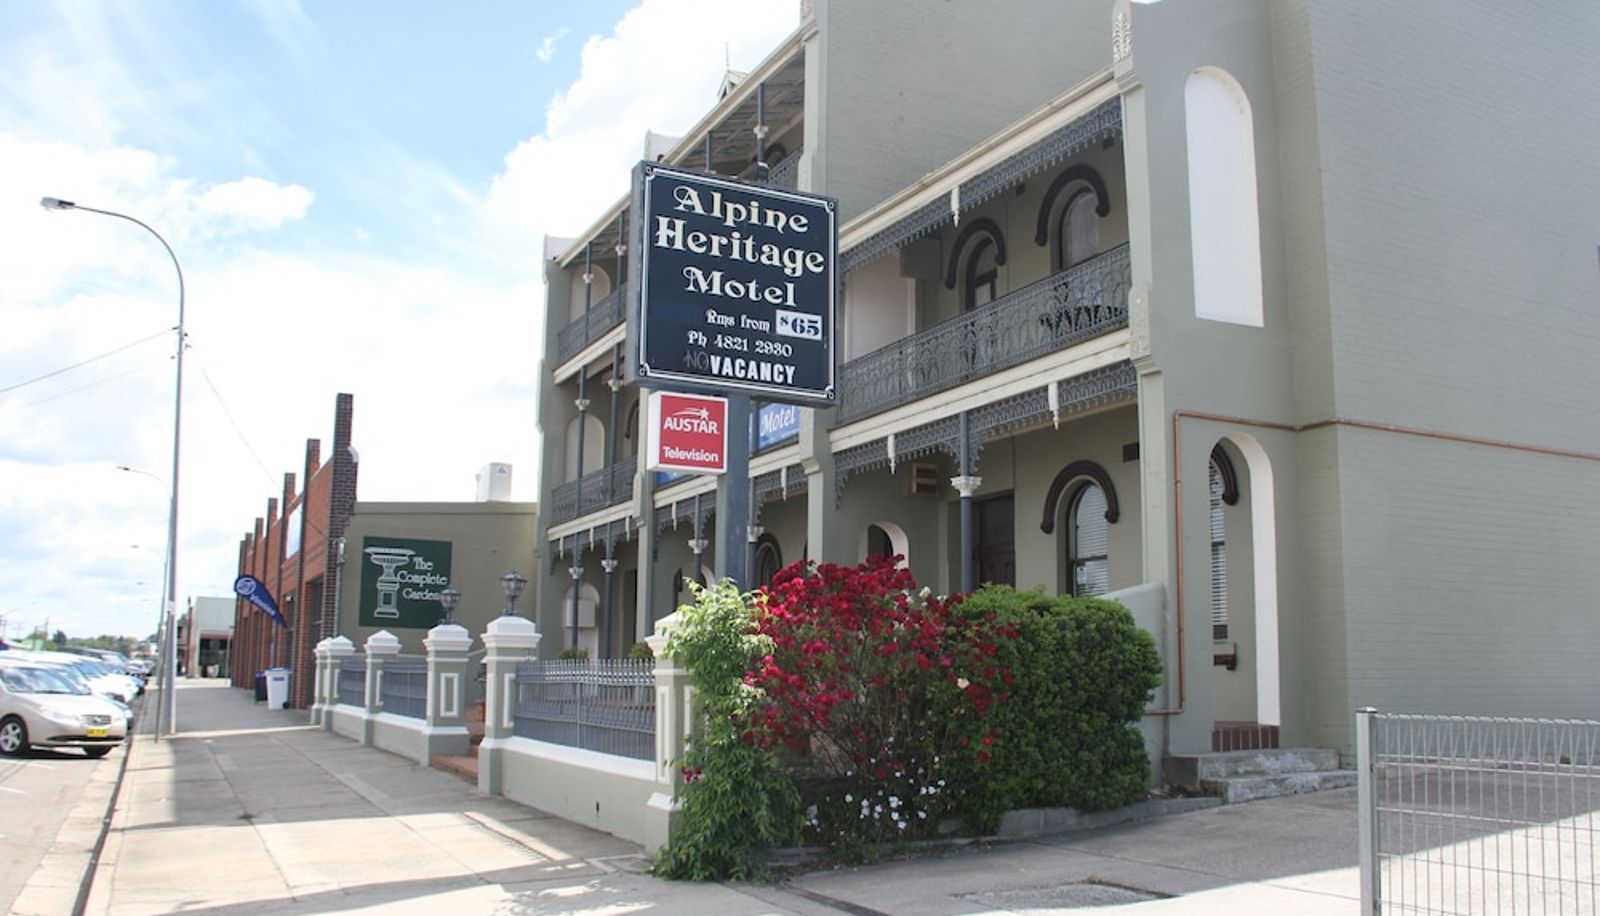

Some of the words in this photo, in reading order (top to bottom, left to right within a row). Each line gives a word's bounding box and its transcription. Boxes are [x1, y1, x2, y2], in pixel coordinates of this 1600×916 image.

[673, 185, 809, 234] Alpine
[654, 215, 825, 277] Heritage
[682, 266, 797, 307] Motel
[704, 308, 736, 328] Rms
[740, 314, 771, 333] from
[779, 315, 820, 337] $65
[686, 330, 708, 349] Ph
[713, 333, 749, 353] 4821
[754, 340, 793, 358] 2930
[710, 354, 796, 385] VACANCY
[663, 416, 719, 434] AUSTAR
[760, 405, 795, 434] Motel
[662, 445, 719, 463] Television
[412, 556, 434, 571] The
[396, 570, 448, 587] Complete
